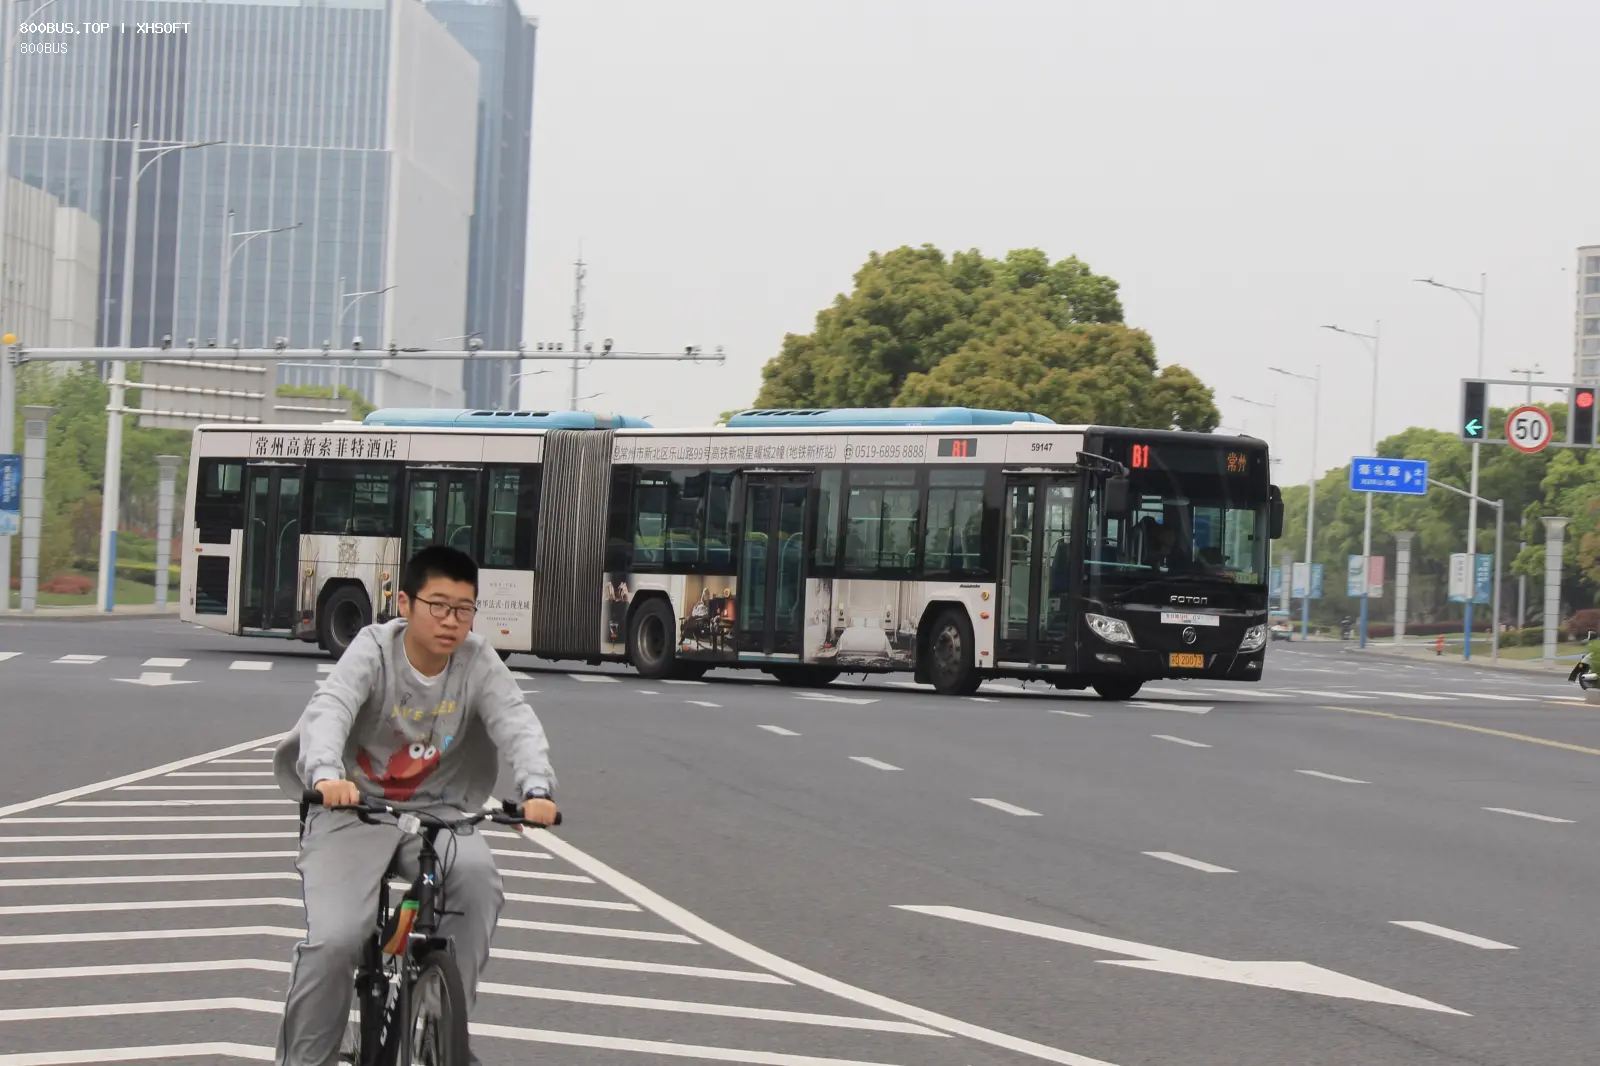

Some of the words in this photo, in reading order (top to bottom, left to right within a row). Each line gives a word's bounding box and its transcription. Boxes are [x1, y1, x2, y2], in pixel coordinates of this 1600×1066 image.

[1515, 418, 1542, 440] 50
[255, 436, 398, 458] 常州高新索菲特酒店
[902, 444, 924, 458] 8888
[1031, 443, 1053, 452] 59147
[1170, 595, 1208, 605] FOTON
